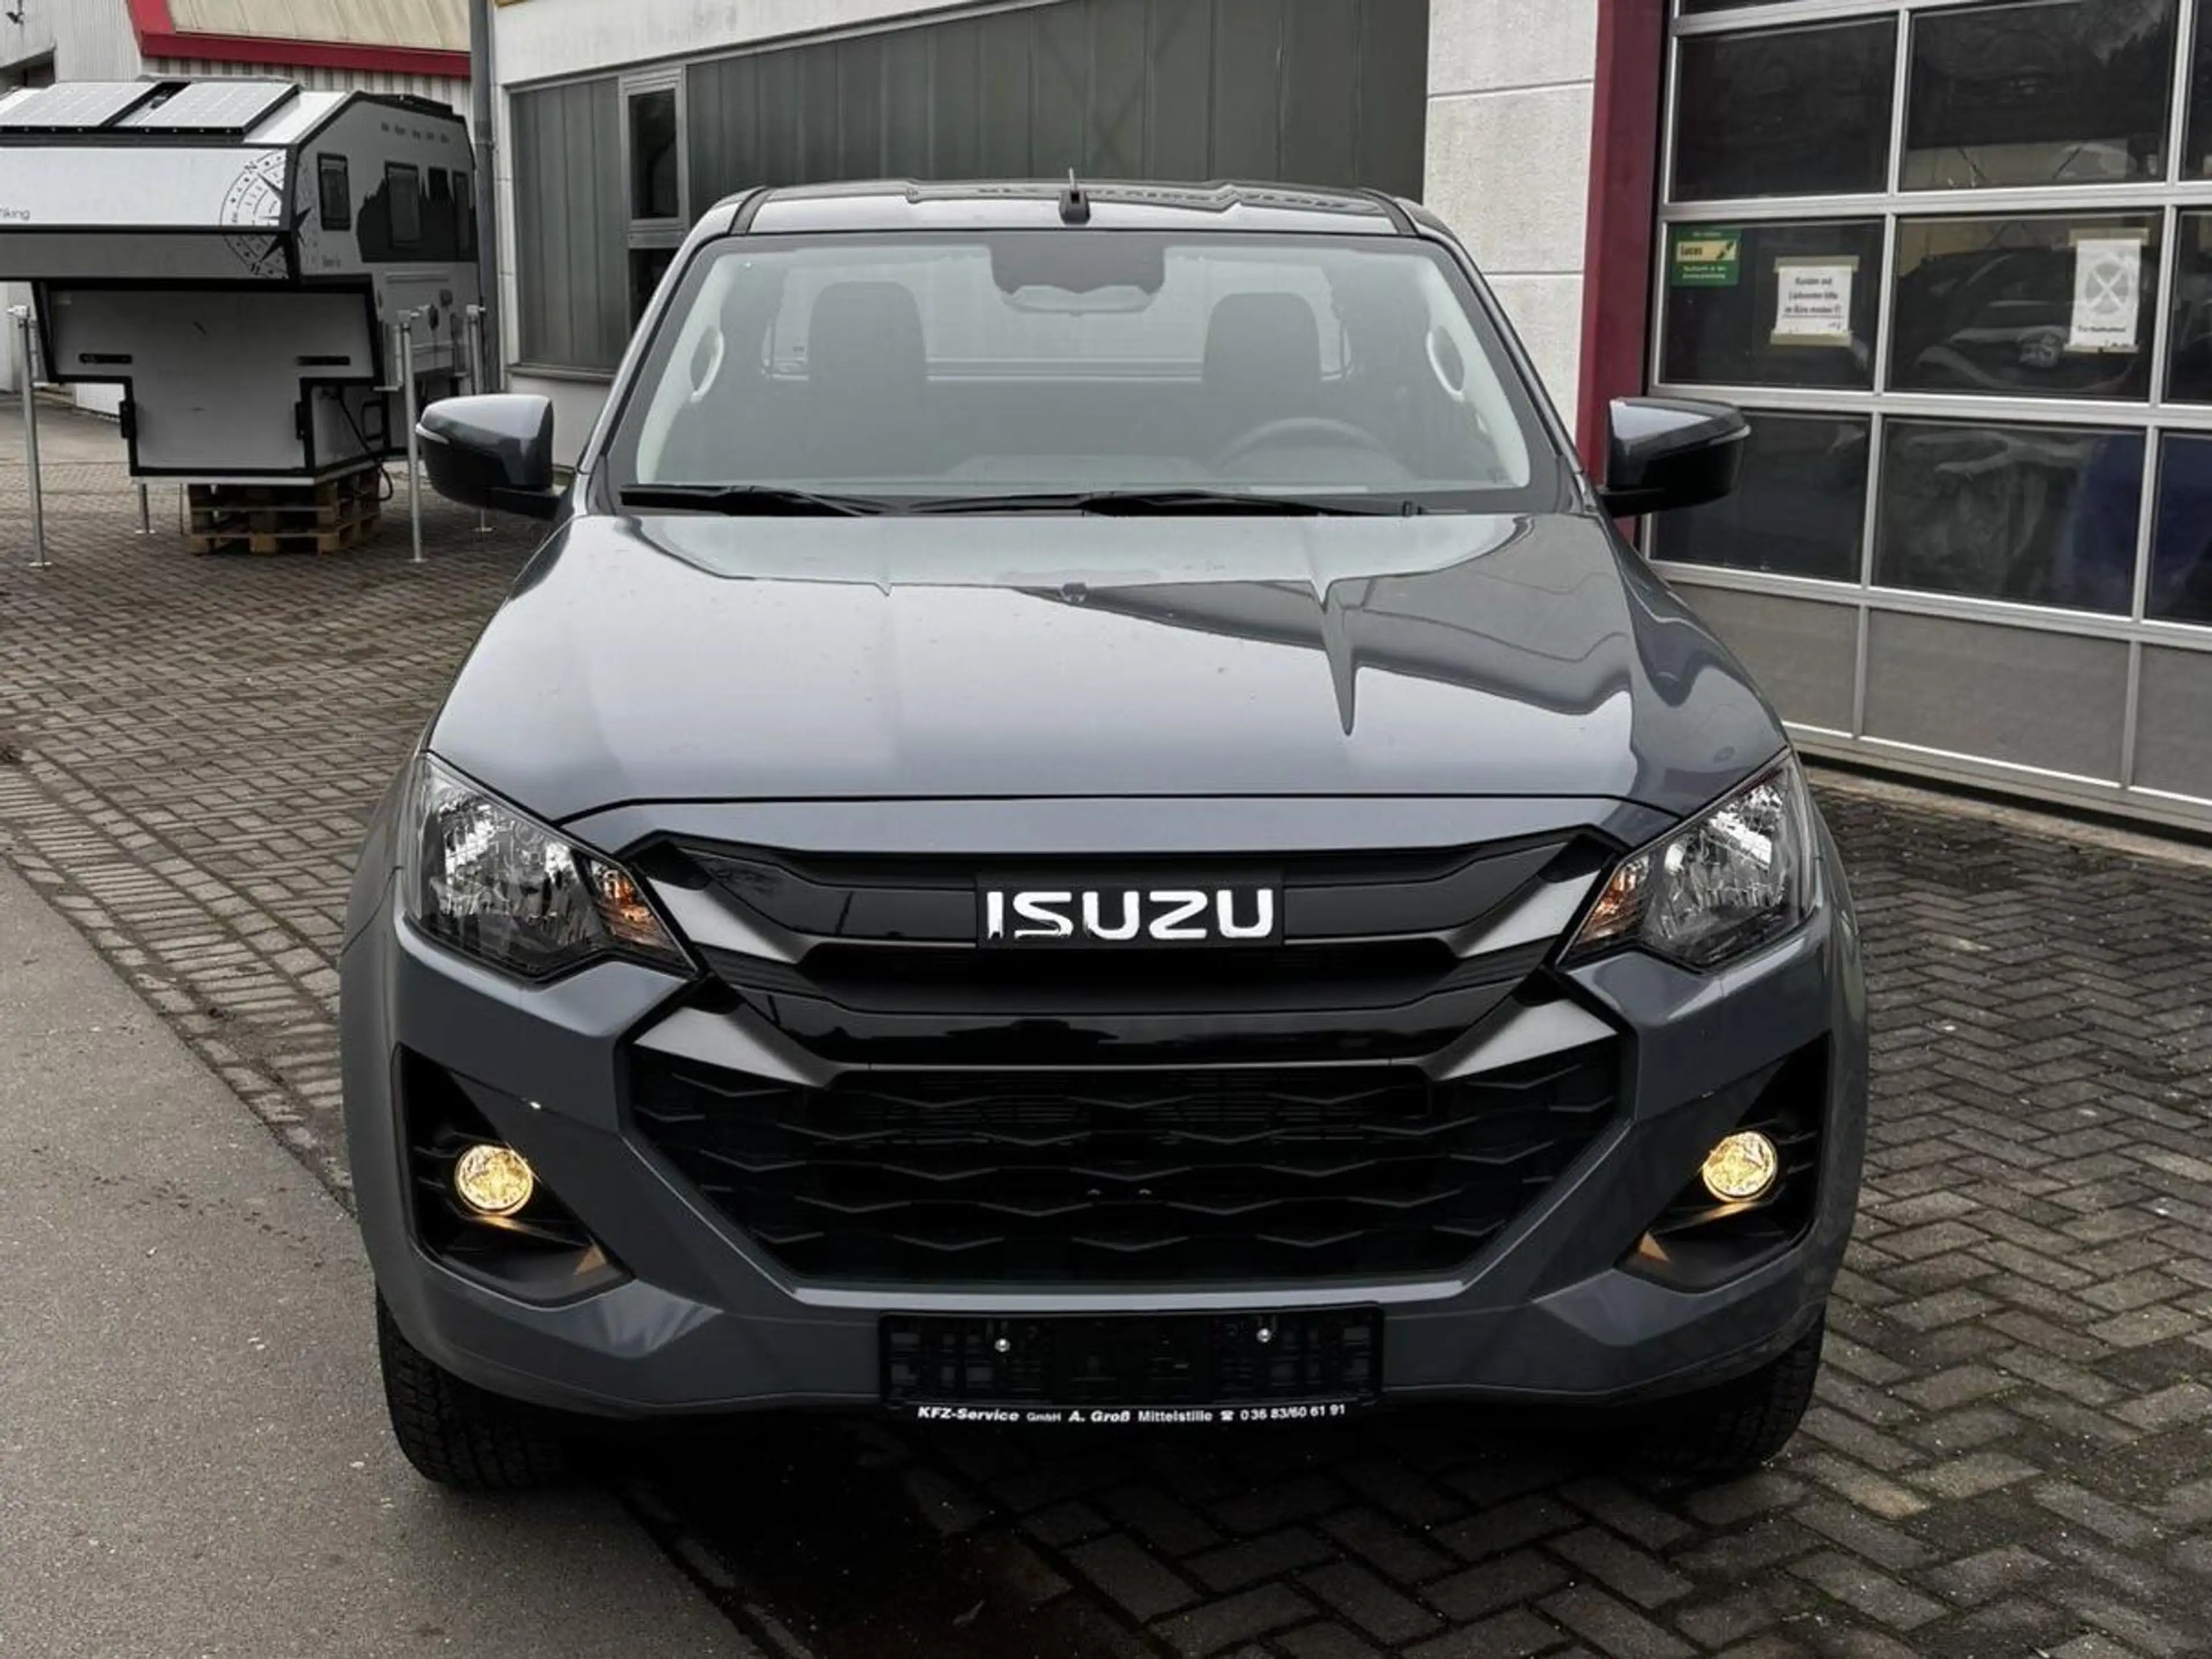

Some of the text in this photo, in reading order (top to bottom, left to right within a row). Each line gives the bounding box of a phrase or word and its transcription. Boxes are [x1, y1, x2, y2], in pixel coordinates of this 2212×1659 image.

[987, 889, 1273, 940] ISUZU
[917, 1406, 1019, 1422] KFZ-Service
[1027, 1412, 1062, 1422] GmbH
[1068, 1410, 1085, 1422] A.
[1090, 1410, 1131, 1423] Groß
[1138, 1410, 1213, 1422] Mittelstille
[1329, 1404, 1345, 1416] 91
